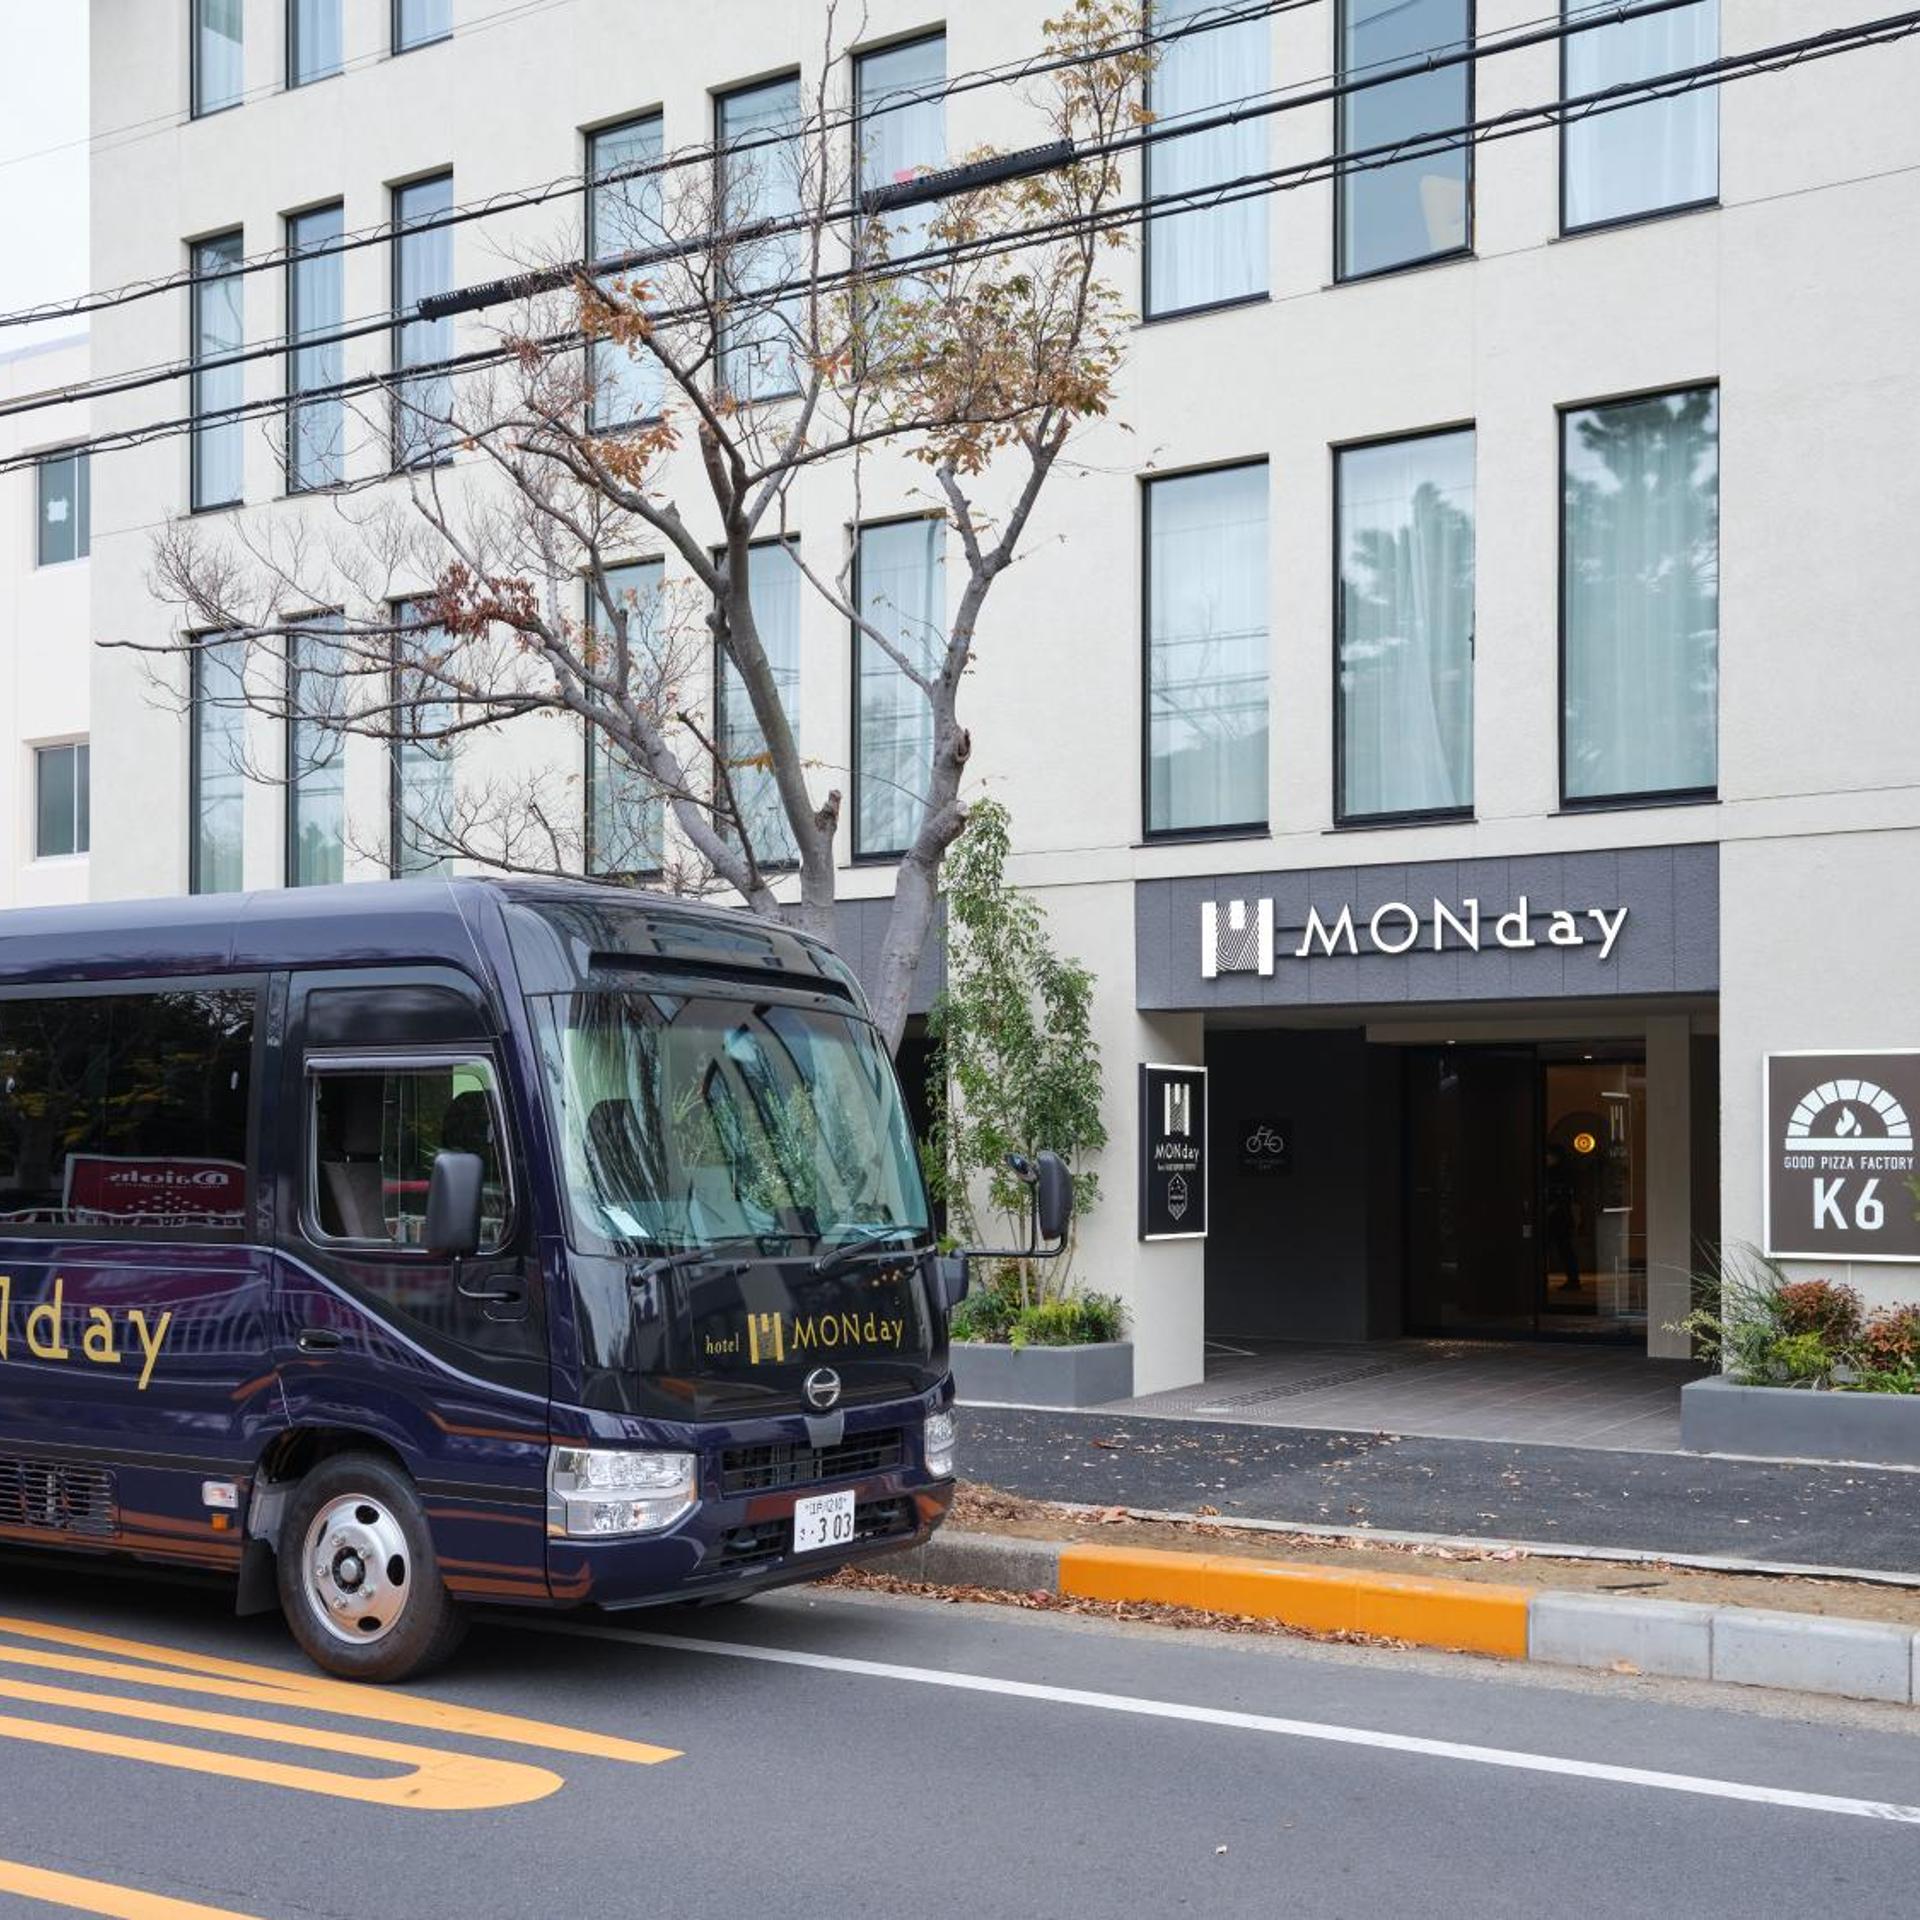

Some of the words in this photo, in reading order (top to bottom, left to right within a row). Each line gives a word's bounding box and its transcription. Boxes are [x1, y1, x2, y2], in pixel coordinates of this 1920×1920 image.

[1296, 895, 1628, 959] MONday
[1154, 1143, 1199, 1161] MONday
[1784, 1156, 1815, 1169] GOOD
[1821, 1156, 1855, 1169] PIZZA
[1861, 1156, 1914, 1169] FACTORY
[0, 1276, 172, 1390] day
[705, 1332, 740, 1354] hotel
[792, 1312, 903, 1348] MONday
